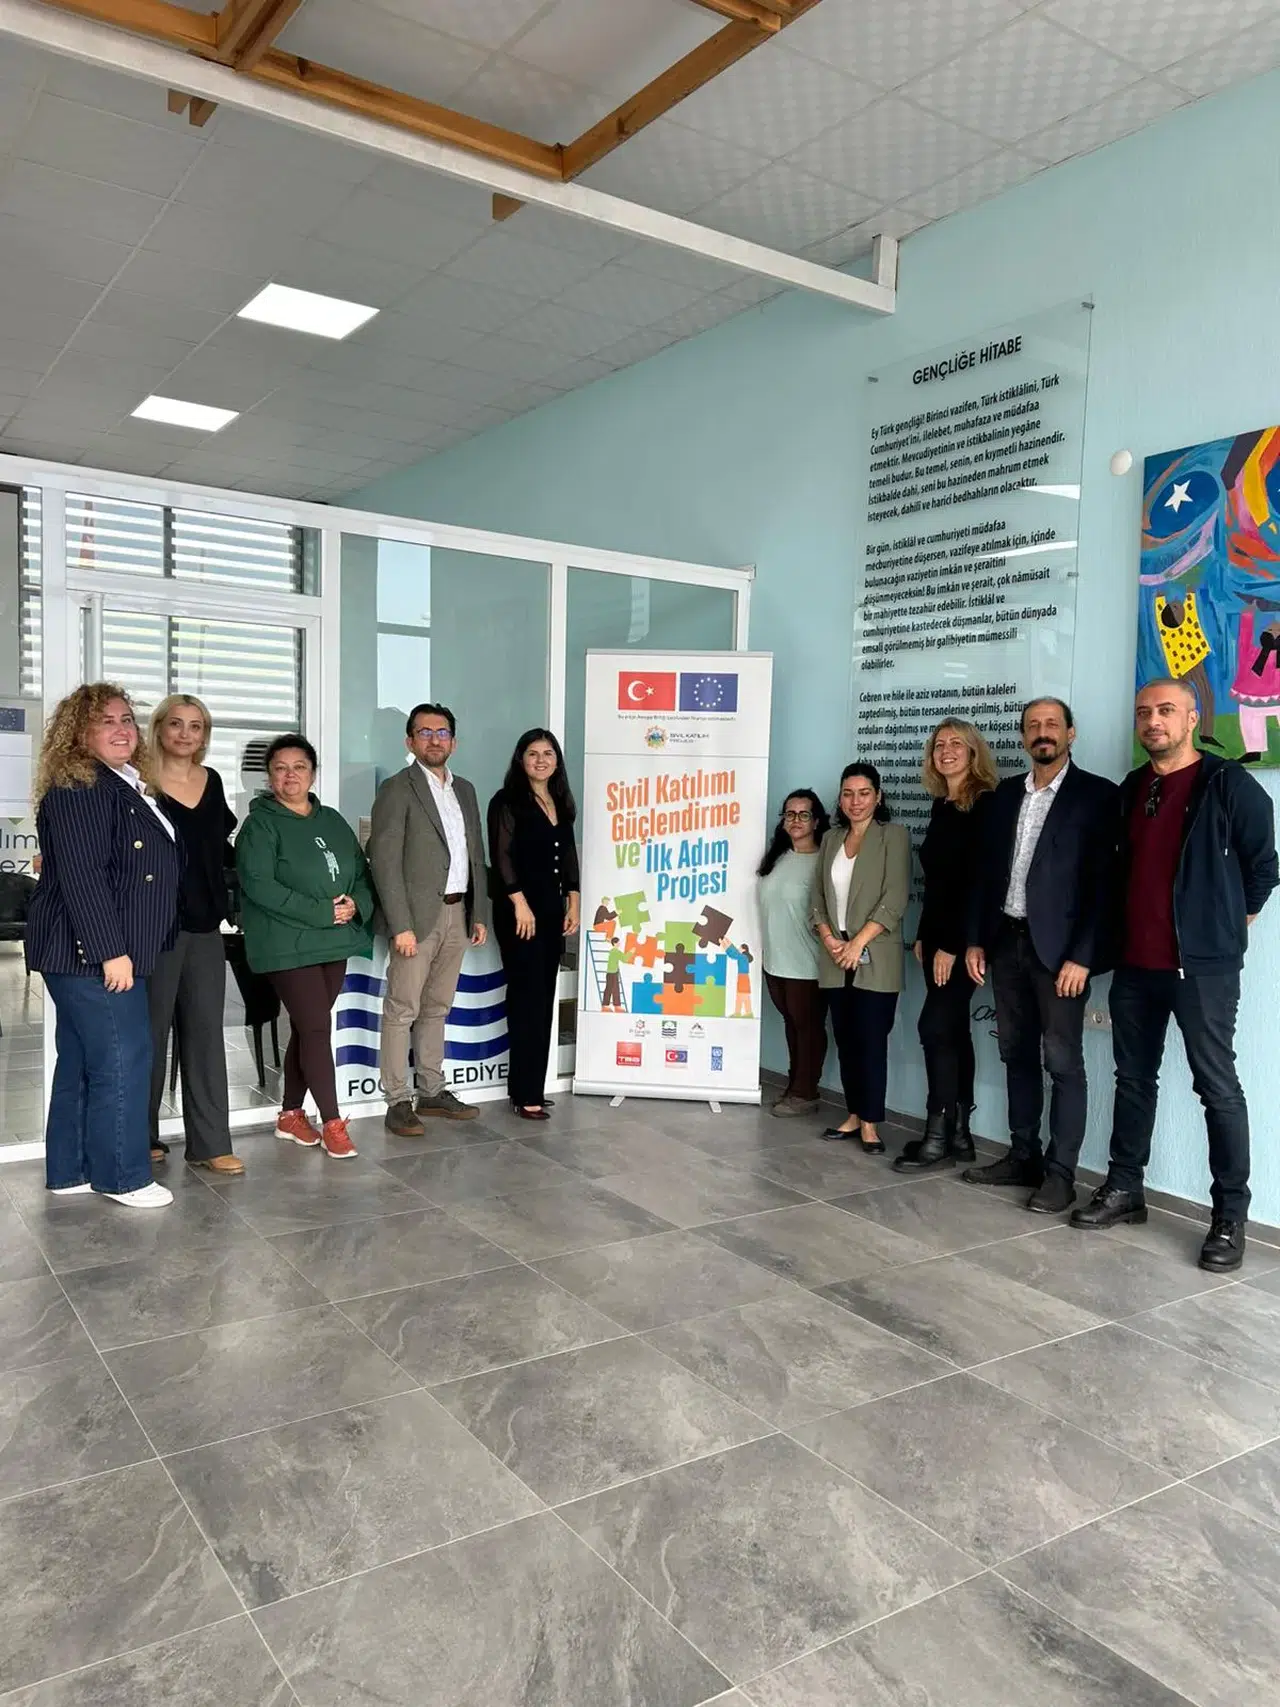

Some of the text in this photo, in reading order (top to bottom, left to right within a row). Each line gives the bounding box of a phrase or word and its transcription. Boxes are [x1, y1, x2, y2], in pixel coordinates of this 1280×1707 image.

[913, 336, 1022, 384] GENÇLİĞE HİTABE
[871, 427, 879, 441] Ey
[880, 422, 894, 436] Türk
[926, 406, 949, 423] Birinci
[950, 400, 980, 416] vazifen,
[980, 392, 998, 407] Türk
[1040, 374, 1060, 389] Türk
[922, 423, 952, 441] ilelebet,
[954, 415, 992, 432] muhafaza
[993, 412, 1002, 421] ve
[1003, 401, 1040, 418] müdafaa
[868, 431, 1065, 489] temeli budur. Bu temel, senin, en kıymetli hazinendir.
[870, 455, 901, 472] etmektir.
[901, 441, 956, 464] Mevcudiyetinin
[956, 440, 965, 449] ve
[966, 427, 1010, 447] istikbalinin
[920, 479, 936, 493] seni
[936, 478, 946, 489] bu
[947, 470, 986, 487] hazineden
[987, 464, 1021, 478] mahrum
[1022, 454, 1049, 470] etmek
[868, 505, 901, 522] isteyecek,
[922, 501, 930, 510] ve
[952, 486, 999, 503] bedhahların
[1000, 477, 1038, 493] olacaktır.
[865, 529, 1056, 571] mecburiyetine düşersen, vazifeye atılmak için, içinde
[866, 543, 876, 555] Bir
[917, 537, 926, 545] ve
[926, 525, 970, 544] cumhuriyeti
[971, 521, 1006, 535] müdafaa
[864, 572, 906, 588] bulunacağın
[906, 567, 938, 582] vaziyetin
[964, 564, 972, 572] ve
[974, 555, 1006, 574] şeraitini
[864, 585, 925, 607] düşünmeyeceksin!
[926, 585, 936, 596] Bu
[960, 582, 970, 591] ve
[971, 575, 996, 592] şerait,
[997, 573, 1011, 588] çok
[862, 605, 1057, 637] cumhuriyetine kastedecek düşmanlar, bütün dünyada
[863, 609, 873, 621] bir
[873, 605, 908, 621] mahiyette
[908, 602, 936, 615] tezahür
[936, 598, 968, 612] edebilir.
[996, 595, 1005, 604] ve
[862, 628, 1018, 655] emsali görülmemiş bir galibiyetin mümessili
[859, 683, 1016, 702] Cebren ve hile ile aziz vatanın, bütün kaleleri
[858, 706, 898, 722] zaptedilmiş,
[899, 705, 920, 717] bütün
[921, 703, 970, 716] tersanelerine
[971, 702, 1002, 717] girilmiş,
[988, 720, 1012, 734] köşesi
[858, 723, 883, 734] orduları
[884, 722, 919, 737] dağıtılmış
[920, 725, 928, 733] ve
[873, 739, 898, 753] edilmiş
[995, 738, 1016, 749] daha
[895, 757, 916, 767] olmak
[996, 756, 1026, 768] hilinde,
[606, 769, 736, 812] Sivil Katılımı
[882, 774, 922, 786] sahip olanla
[612, 800, 741, 846] Güçlendirme
[615, 842, 640, 868] ve
[678, 837, 728, 869] Adım
[657, 864, 728, 904] Projesi
